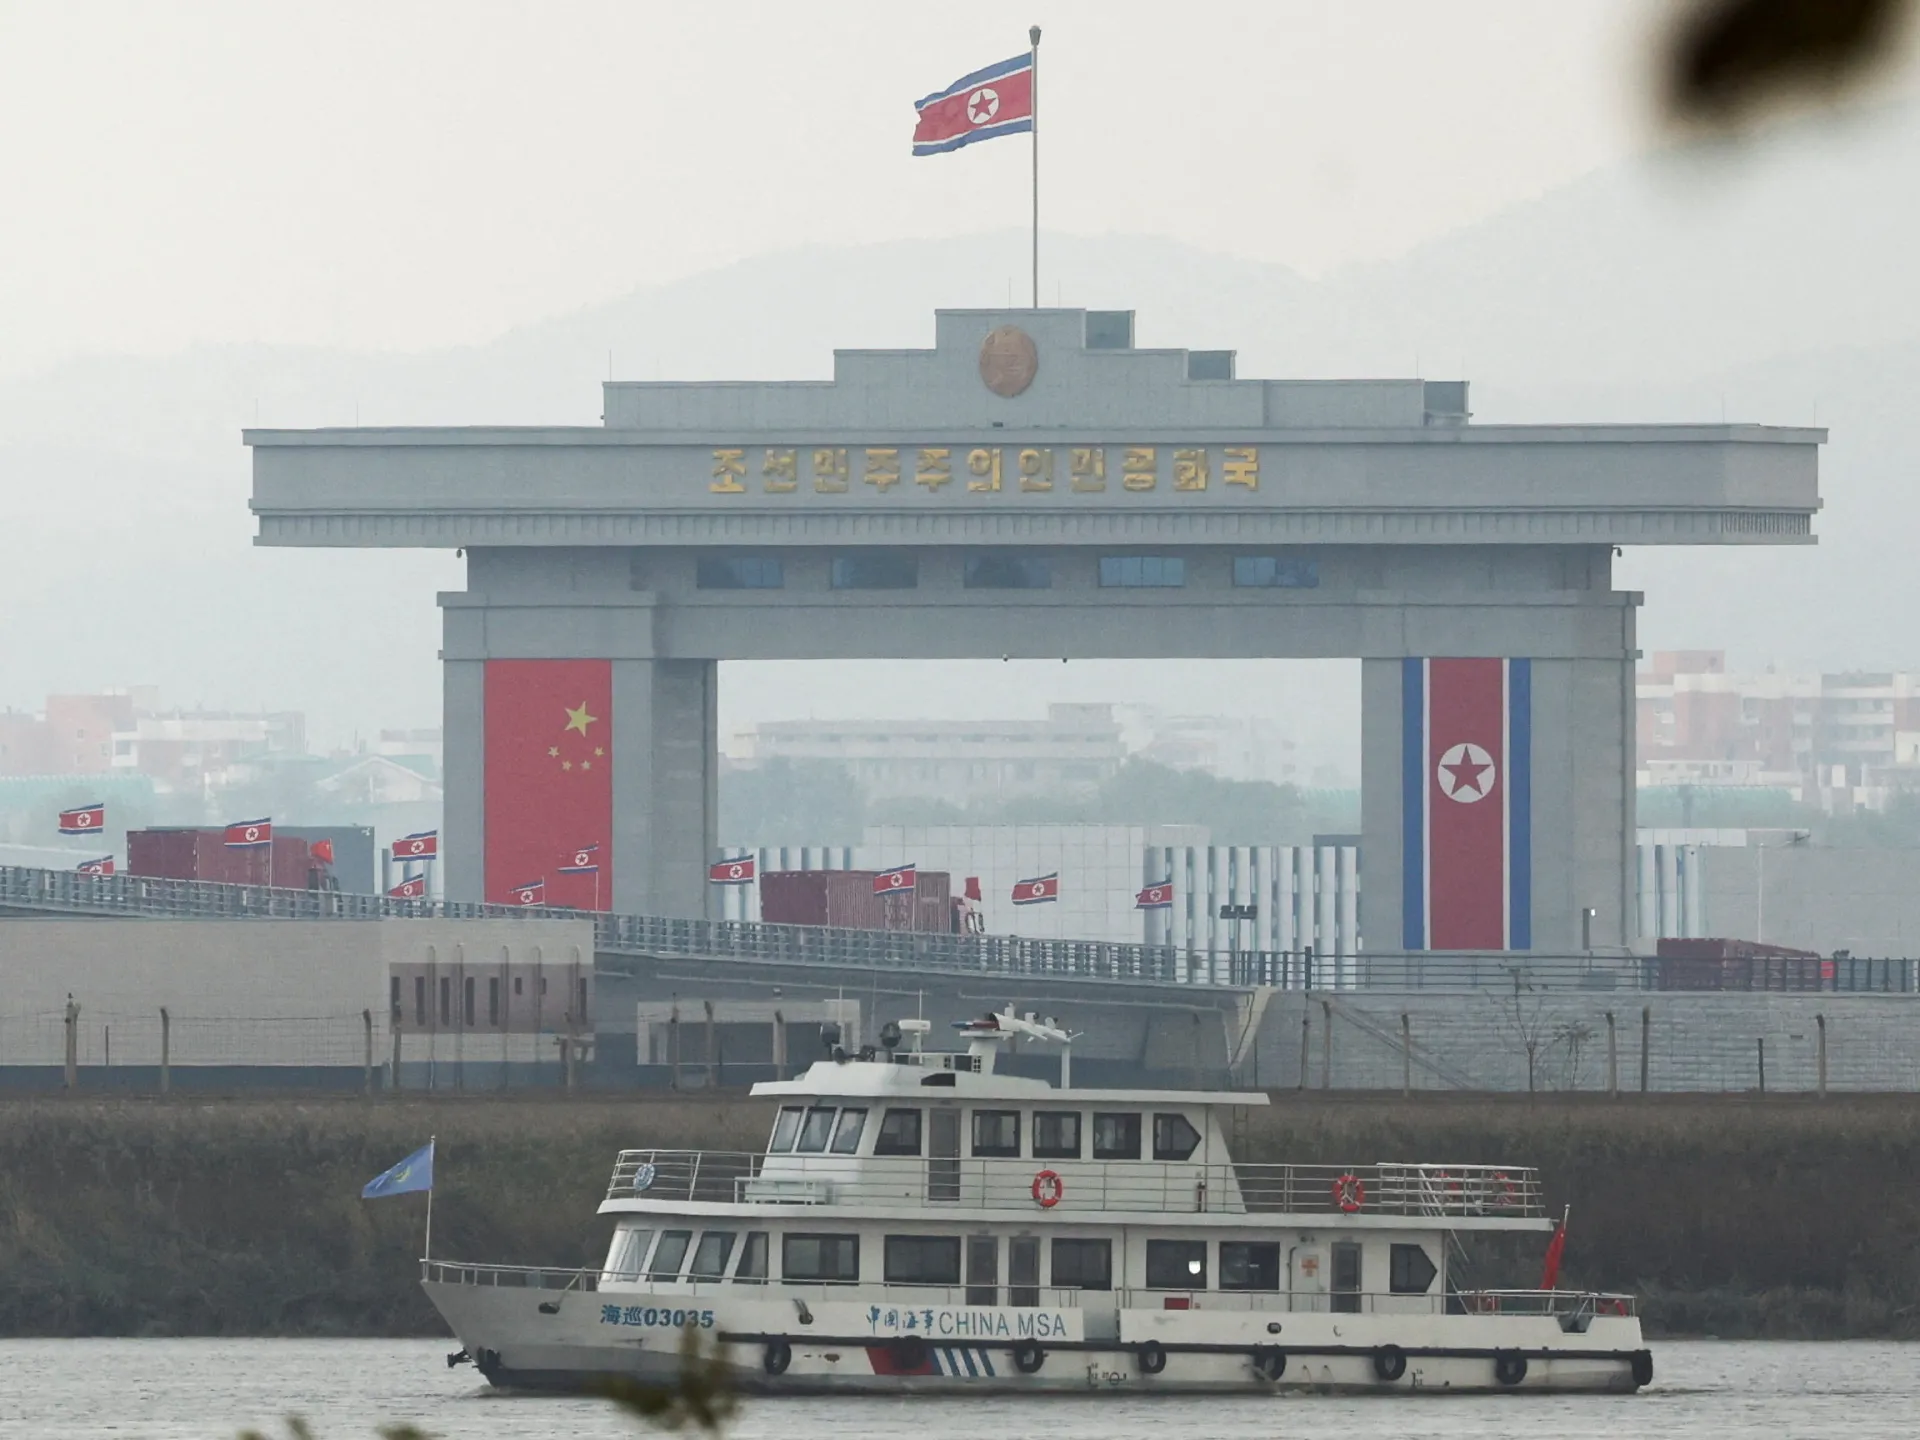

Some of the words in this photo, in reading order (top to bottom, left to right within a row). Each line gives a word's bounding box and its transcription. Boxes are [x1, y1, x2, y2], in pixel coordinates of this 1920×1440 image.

[709, 449, 1258, 493] 조선민주주의인민공화국
[939, 1311, 1009, 1336] CHINA
[1018, 1313, 1066, 1337] MSA
